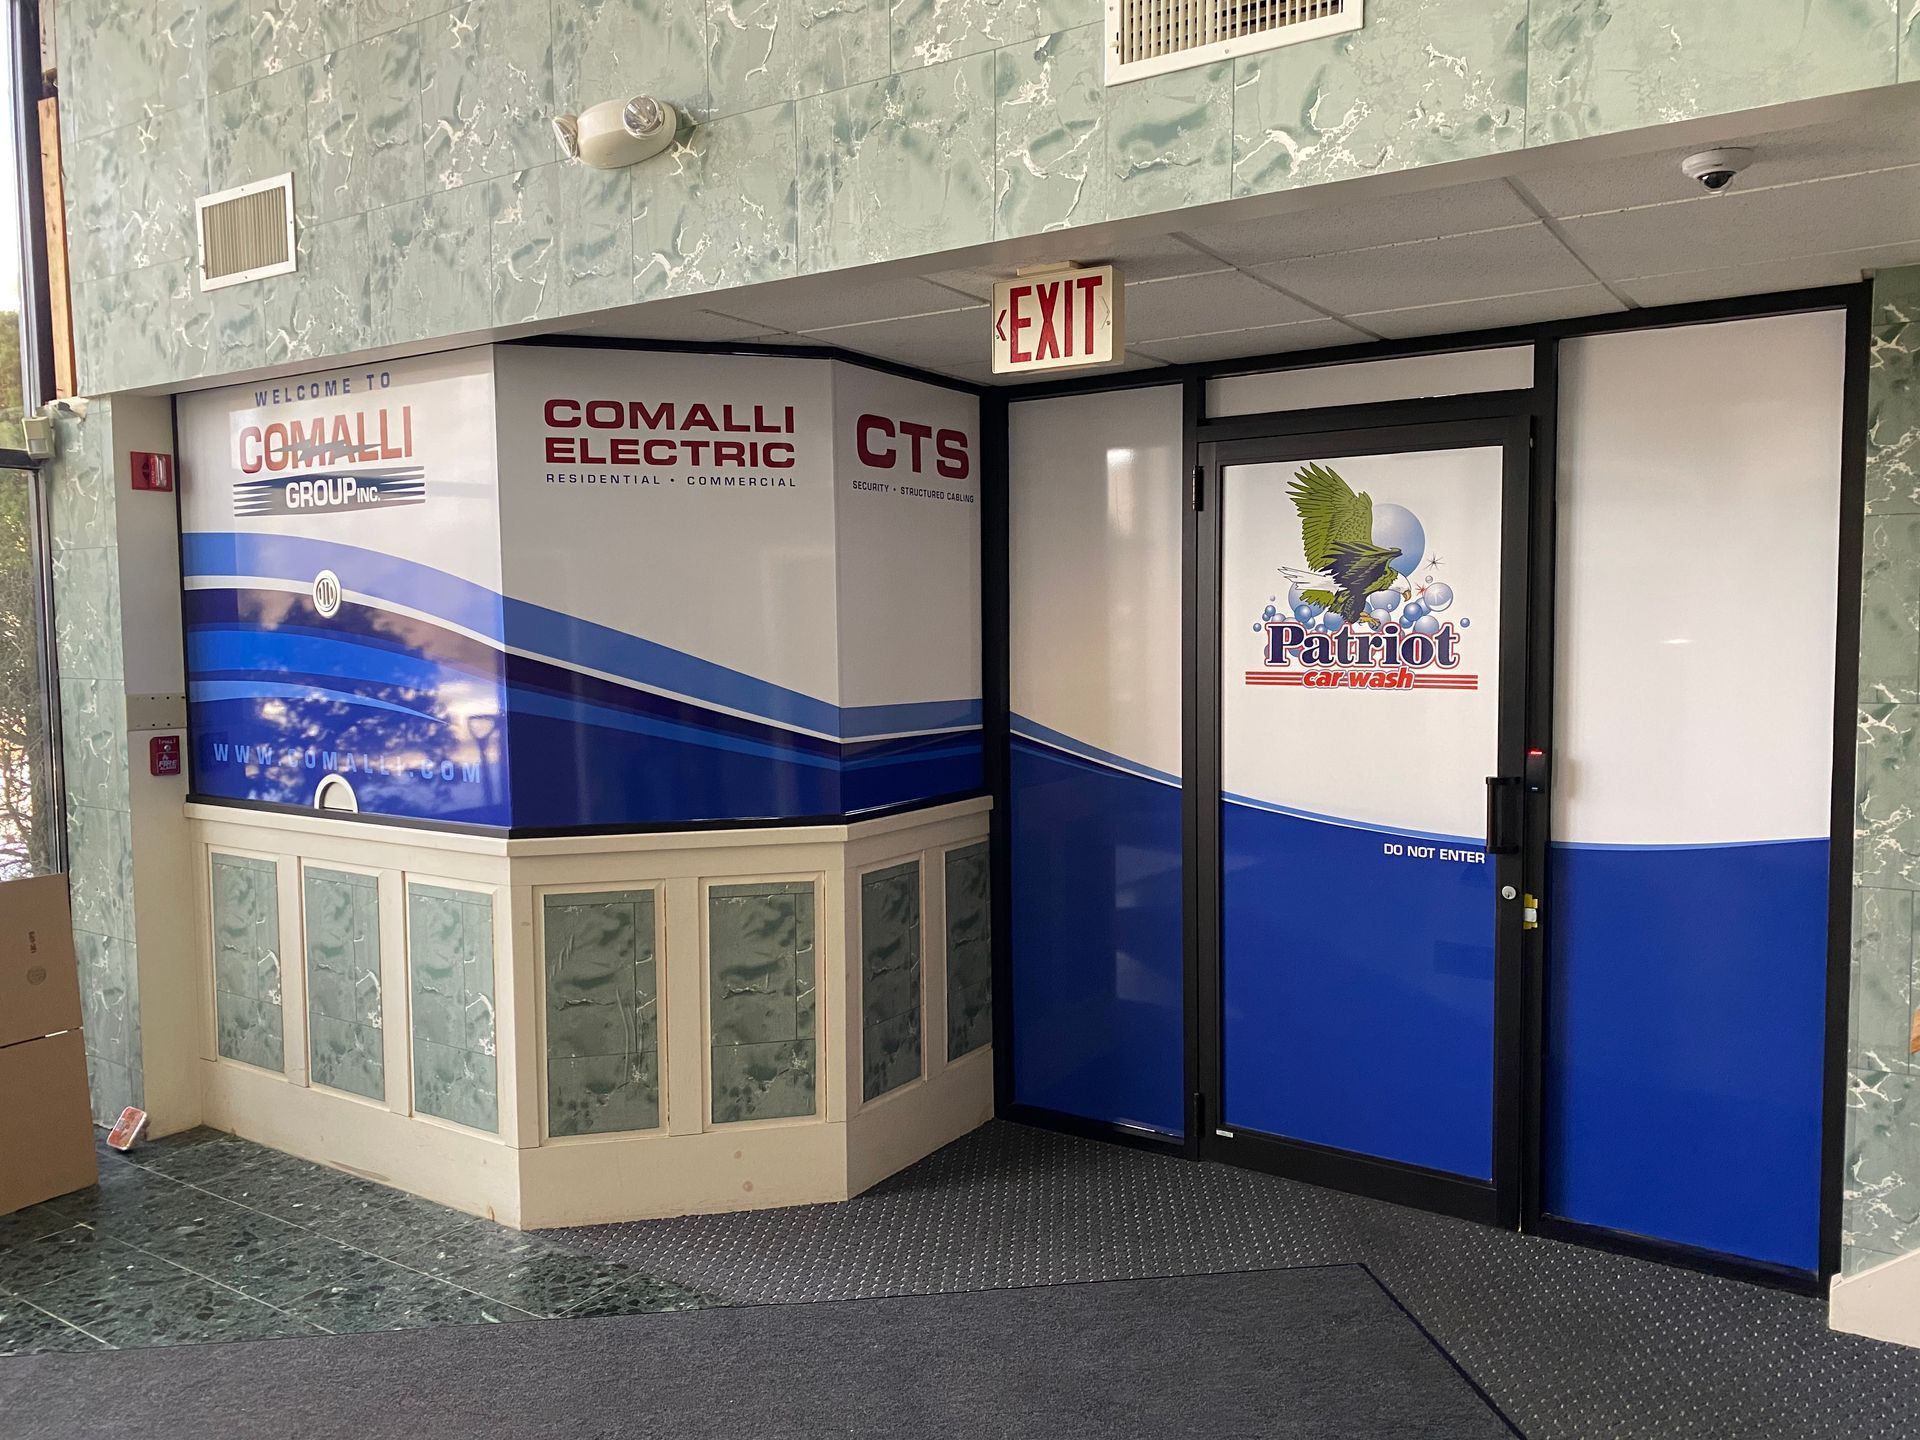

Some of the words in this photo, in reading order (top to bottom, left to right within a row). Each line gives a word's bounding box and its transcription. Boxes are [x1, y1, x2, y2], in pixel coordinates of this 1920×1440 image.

[1009, 275, 1103, 364] EXIT
[255, 377, 351, 407] WELCOME
[366, 371, 391, 389] TO
[543, 399, 795, 434] COMALLI
[239, 405, 413, 474] COMALLI
[545, 437, 796, 468] ELECTRIC
[856, 413, 970, 480] CTS
[285, 477, 357, 509] GROUP
[356, 485, 381, 504] INC.
[546, 473, 661, 485] RESIDENTIAL
[687, 476, 797, 487] COMMERCIAL
[852, 480, 889, 493] SECURITY
[900, 486, 945, 500] STRUCTURED
[946, 492, 974, 503] CABLING
[1264, 621, 1461, 669] Patriot
[158, 760, 177, 768] FIRE
[1383, 843, 1403, 856] DO
[1407, 845, 1436, 859] NOT
[1439, 848, 1486, 864] ENTER
